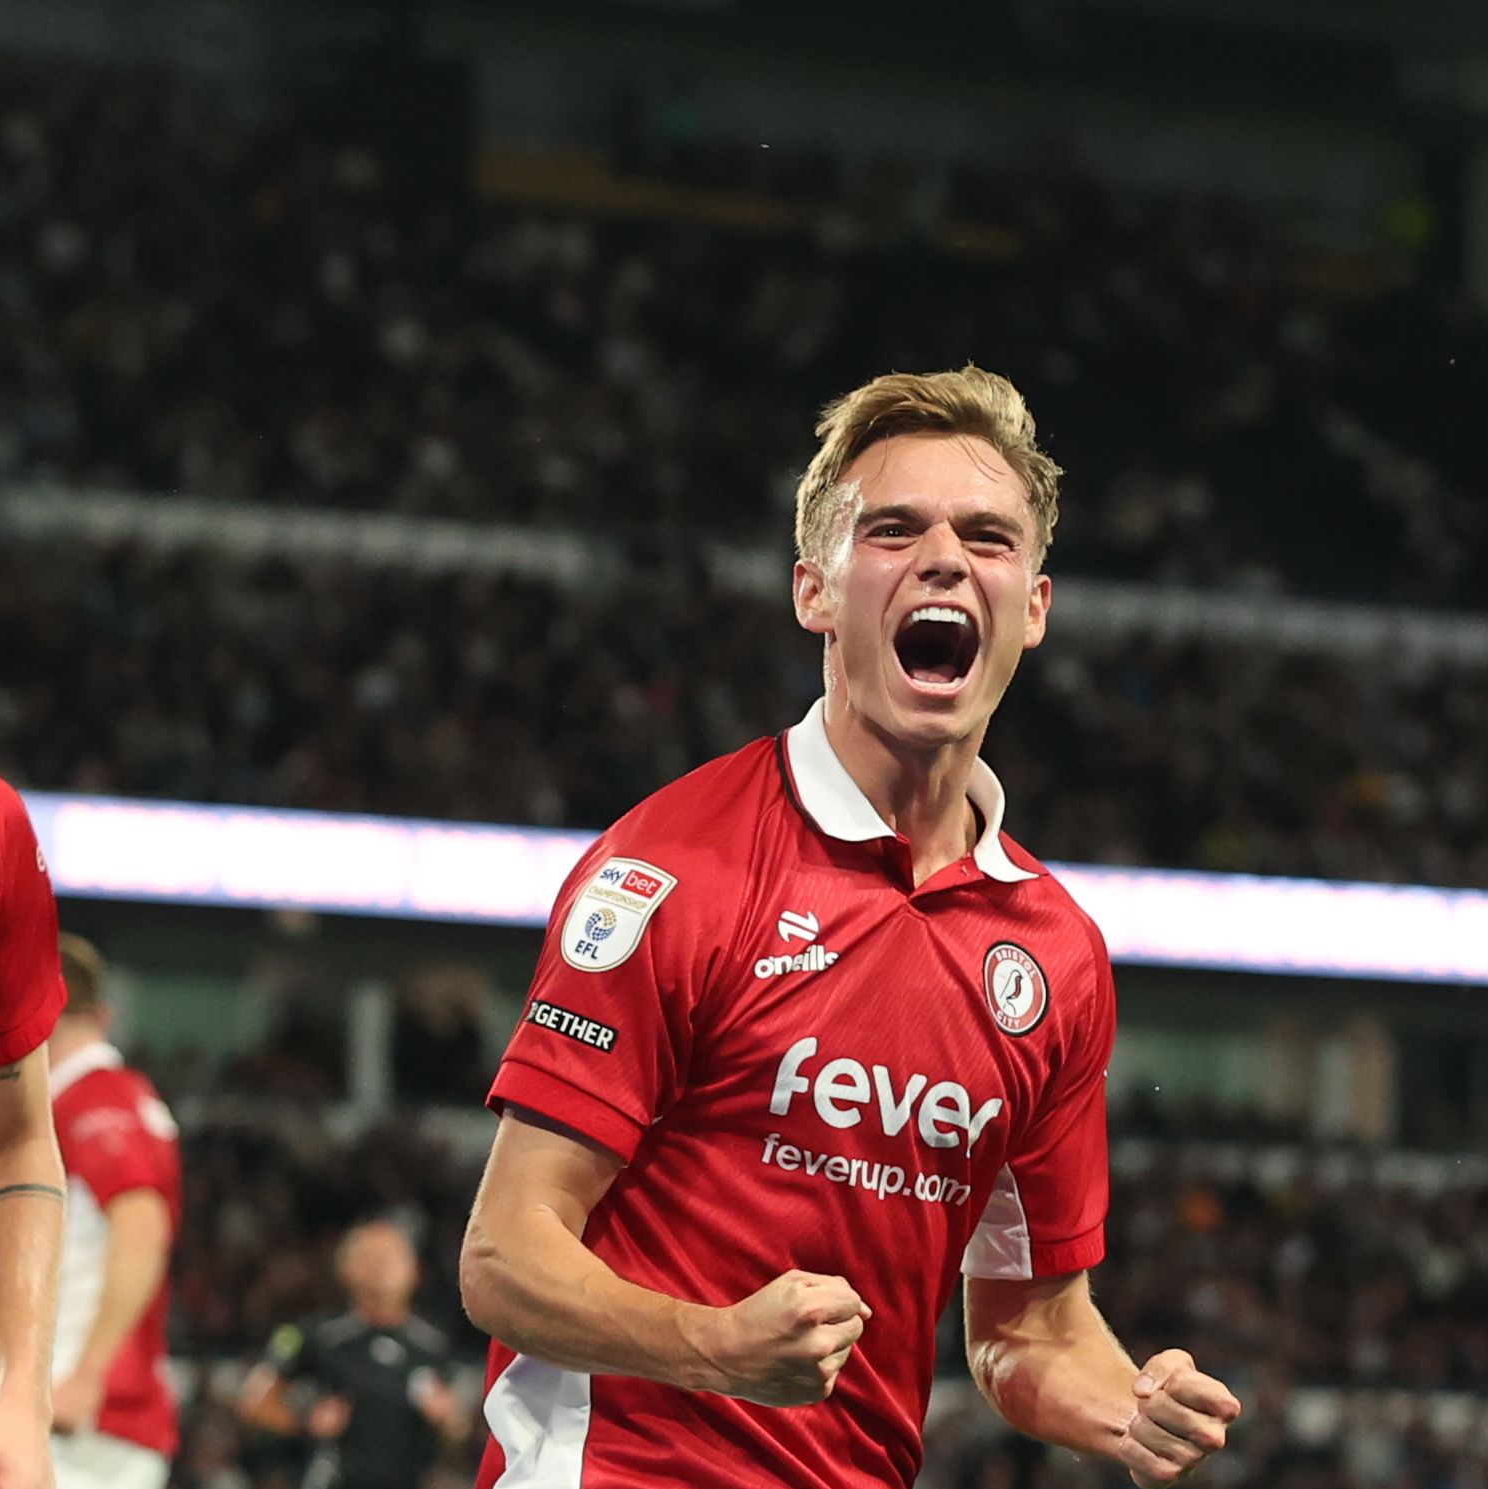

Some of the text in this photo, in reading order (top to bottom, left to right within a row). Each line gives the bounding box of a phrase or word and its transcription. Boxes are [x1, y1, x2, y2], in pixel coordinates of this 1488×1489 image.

[626, 871, 657, 894] bet
[575, 940, 599, 960] EFL
[995, 949, 1036, 979] BRISTOL
[996, 1010, 1020, 1028] CITY
[769, 1036, 1003, 1158] fever
[761, 1133, 971, 1206] feverup.com
